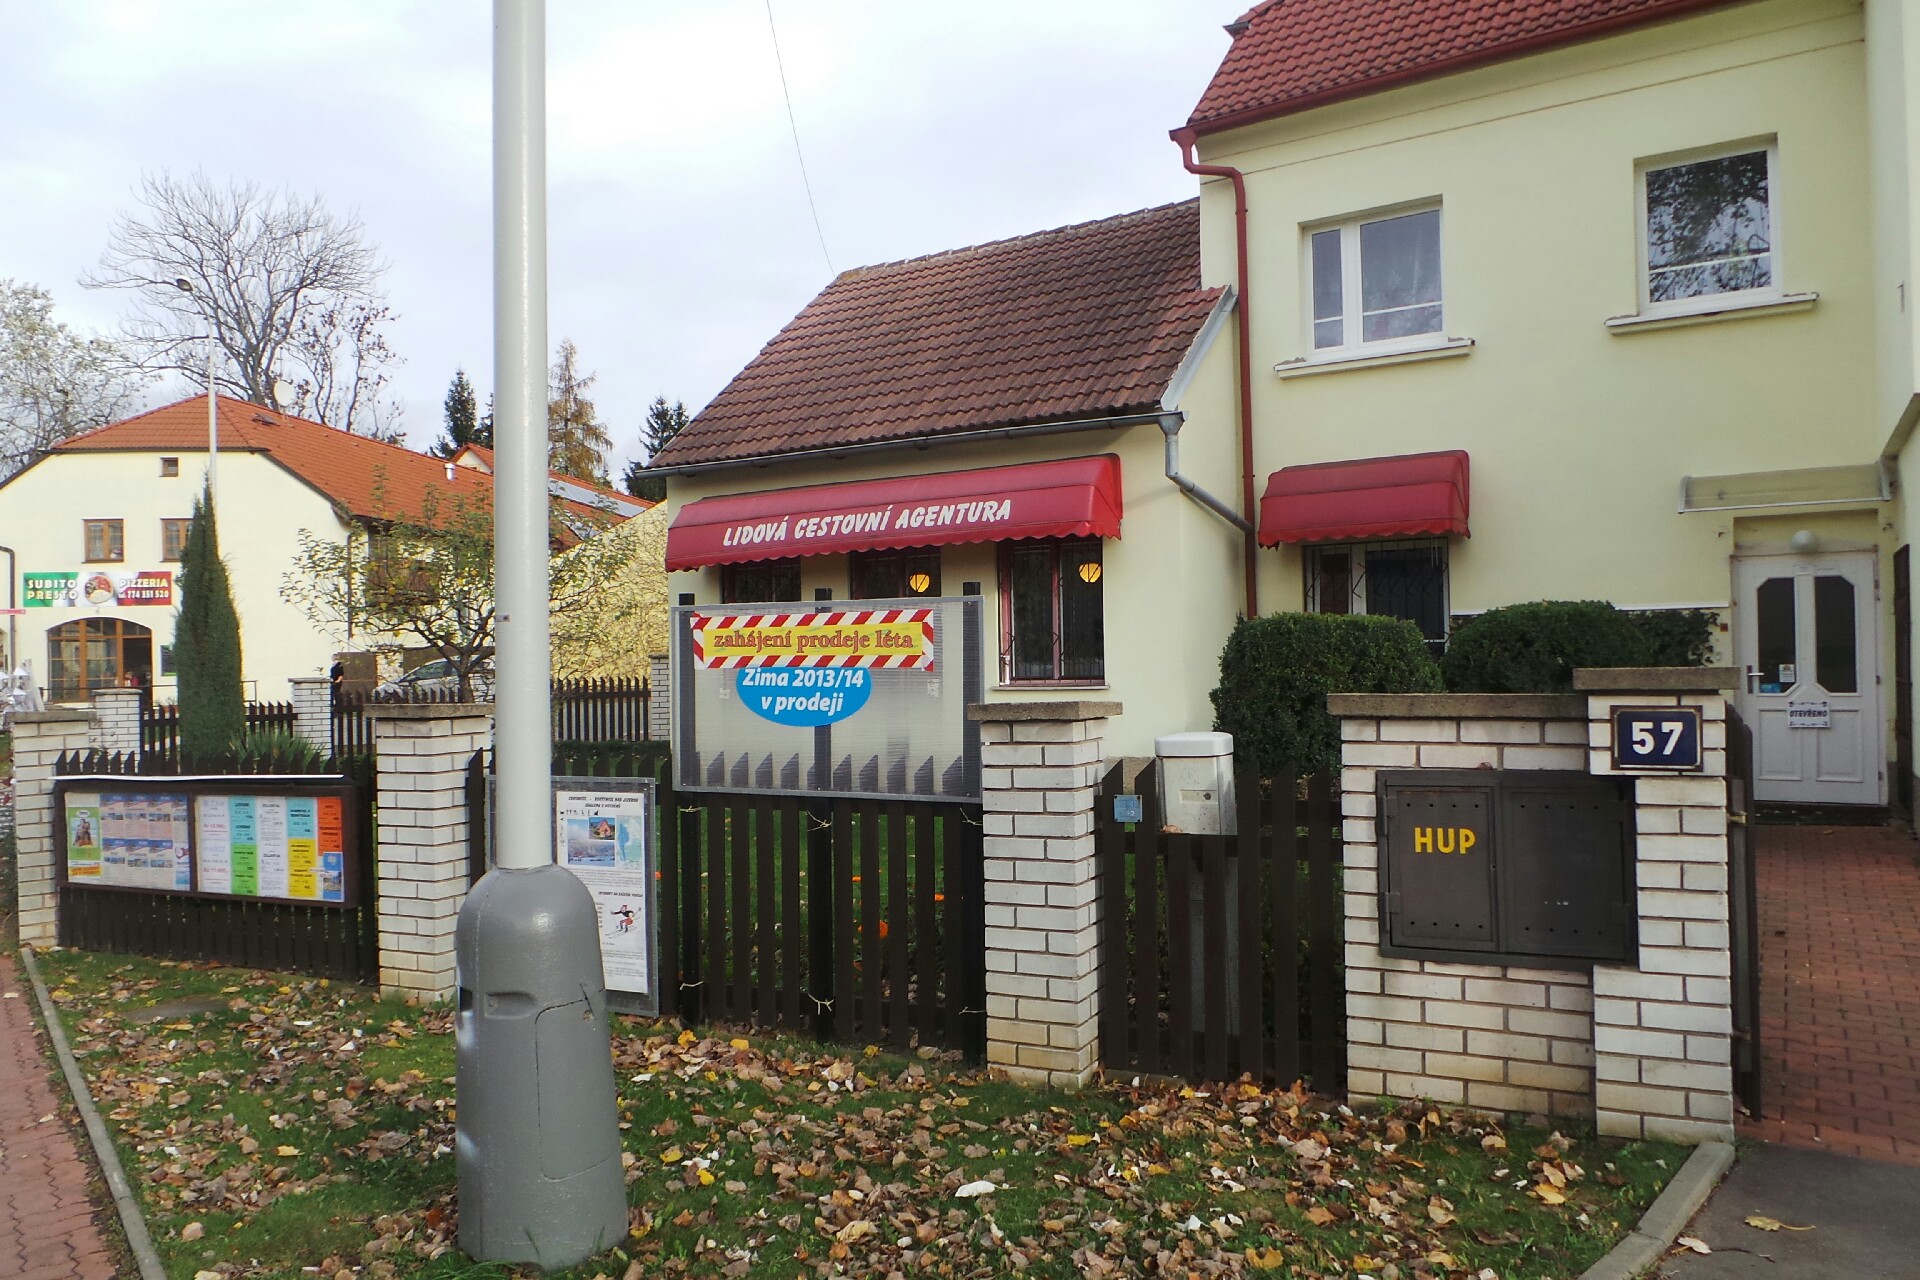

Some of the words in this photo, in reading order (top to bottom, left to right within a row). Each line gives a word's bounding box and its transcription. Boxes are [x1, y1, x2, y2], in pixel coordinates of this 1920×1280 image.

[723, 516, 788, 546] LIDOVÁ
[794, 505, 893, 540] CESTOVNÍ
[895, 499, 1012, 530] AGENTURA
[27, 579, 77, 589] SUBITO
[119, 578, 169, 588] PIZZERIA
[27, 590, 78, 600] PRESTO
[714, 630, 792, 653] zahájení
[796, 631, 870, 653] prodeje
[874, 629, 913, 648] léta
[742, 668, 788, 687] Zima
[792, 668, 864, 689] 2013/14
[761, 696, 772, 711] v
[774, 692, 844, 717] prodeji
[1789, 709, 1828, 718] OTEVŘENO
[1631, 721, 1685, 756] 57
[1414, 827, 1476, 854] HUP
